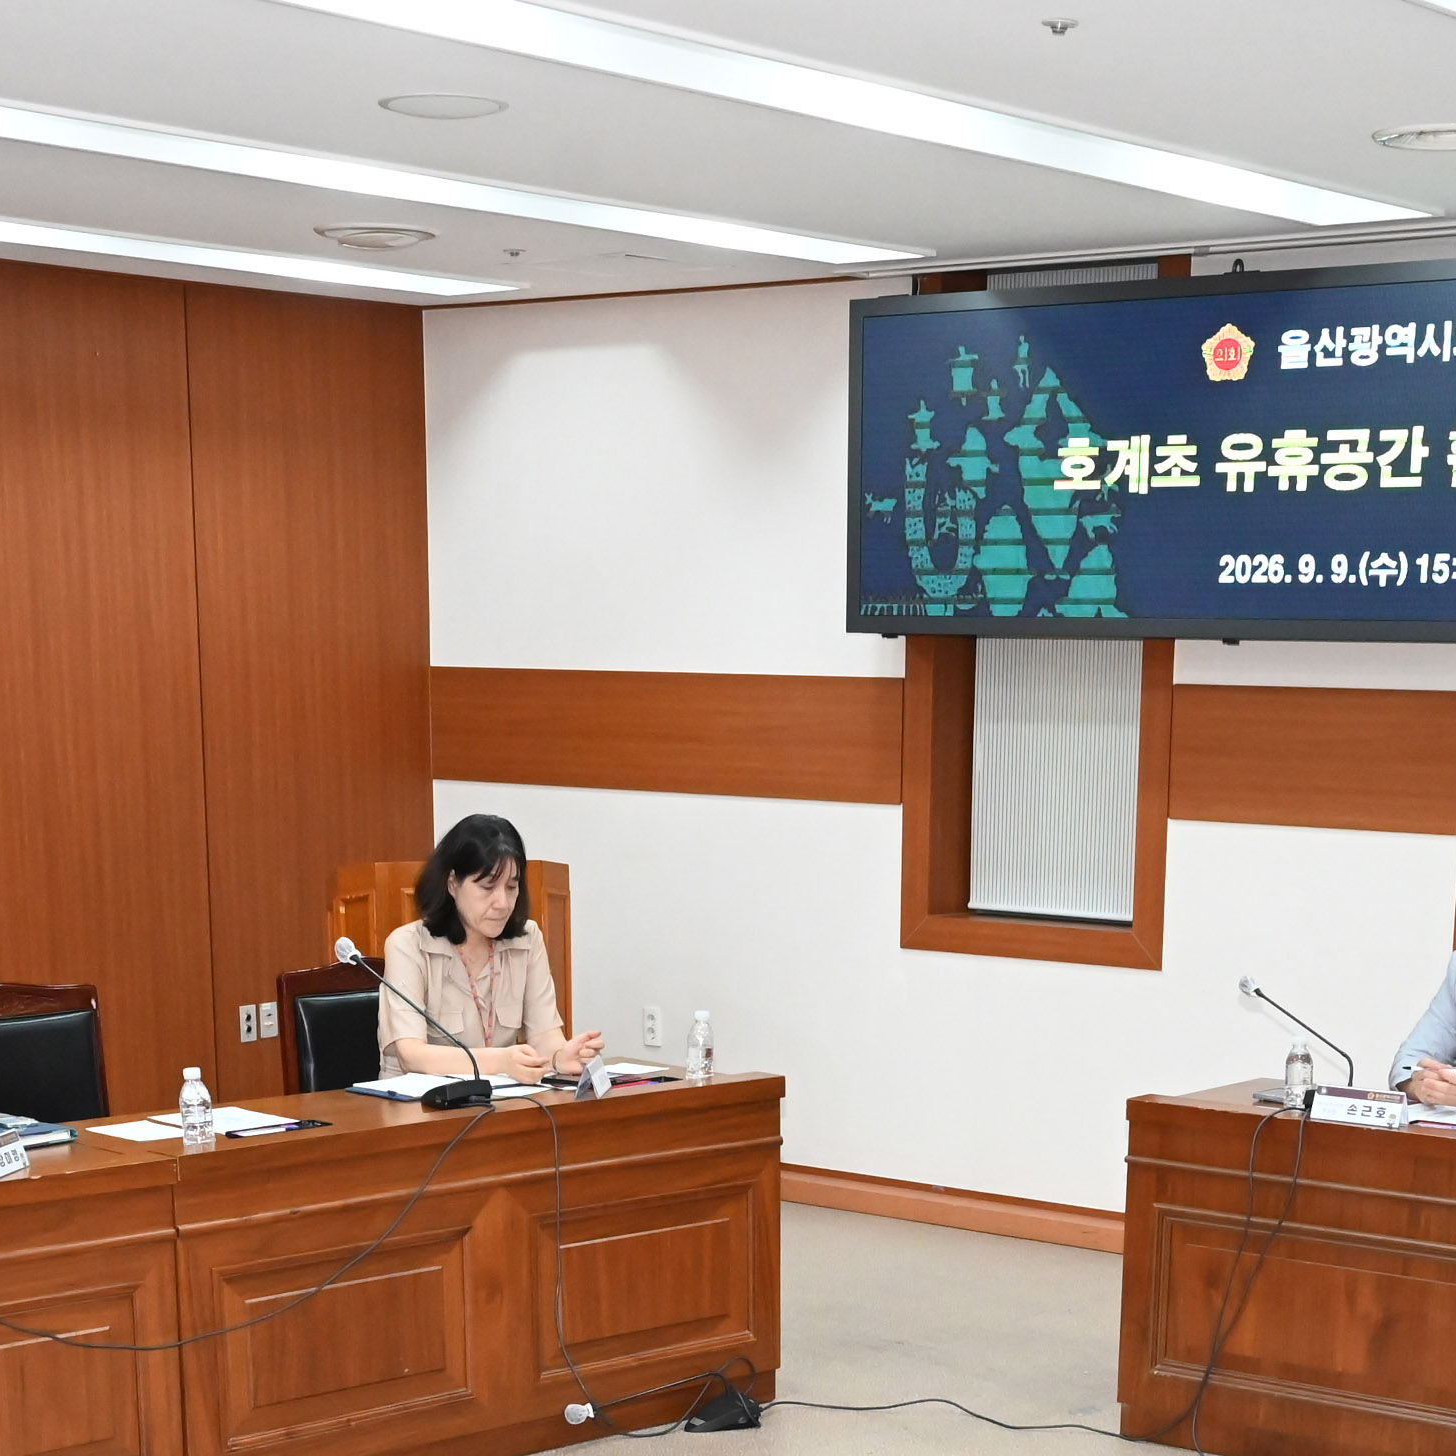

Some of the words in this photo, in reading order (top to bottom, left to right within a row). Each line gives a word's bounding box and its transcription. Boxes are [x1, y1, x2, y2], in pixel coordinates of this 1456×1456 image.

[1053, 434, 1201, 495] 호계초
[1215, 425, 1430, 493] 유휴공간
[1218, 553, 1292, 584] 2026.
[1347, 1104, 1386, 1118] 손근호
